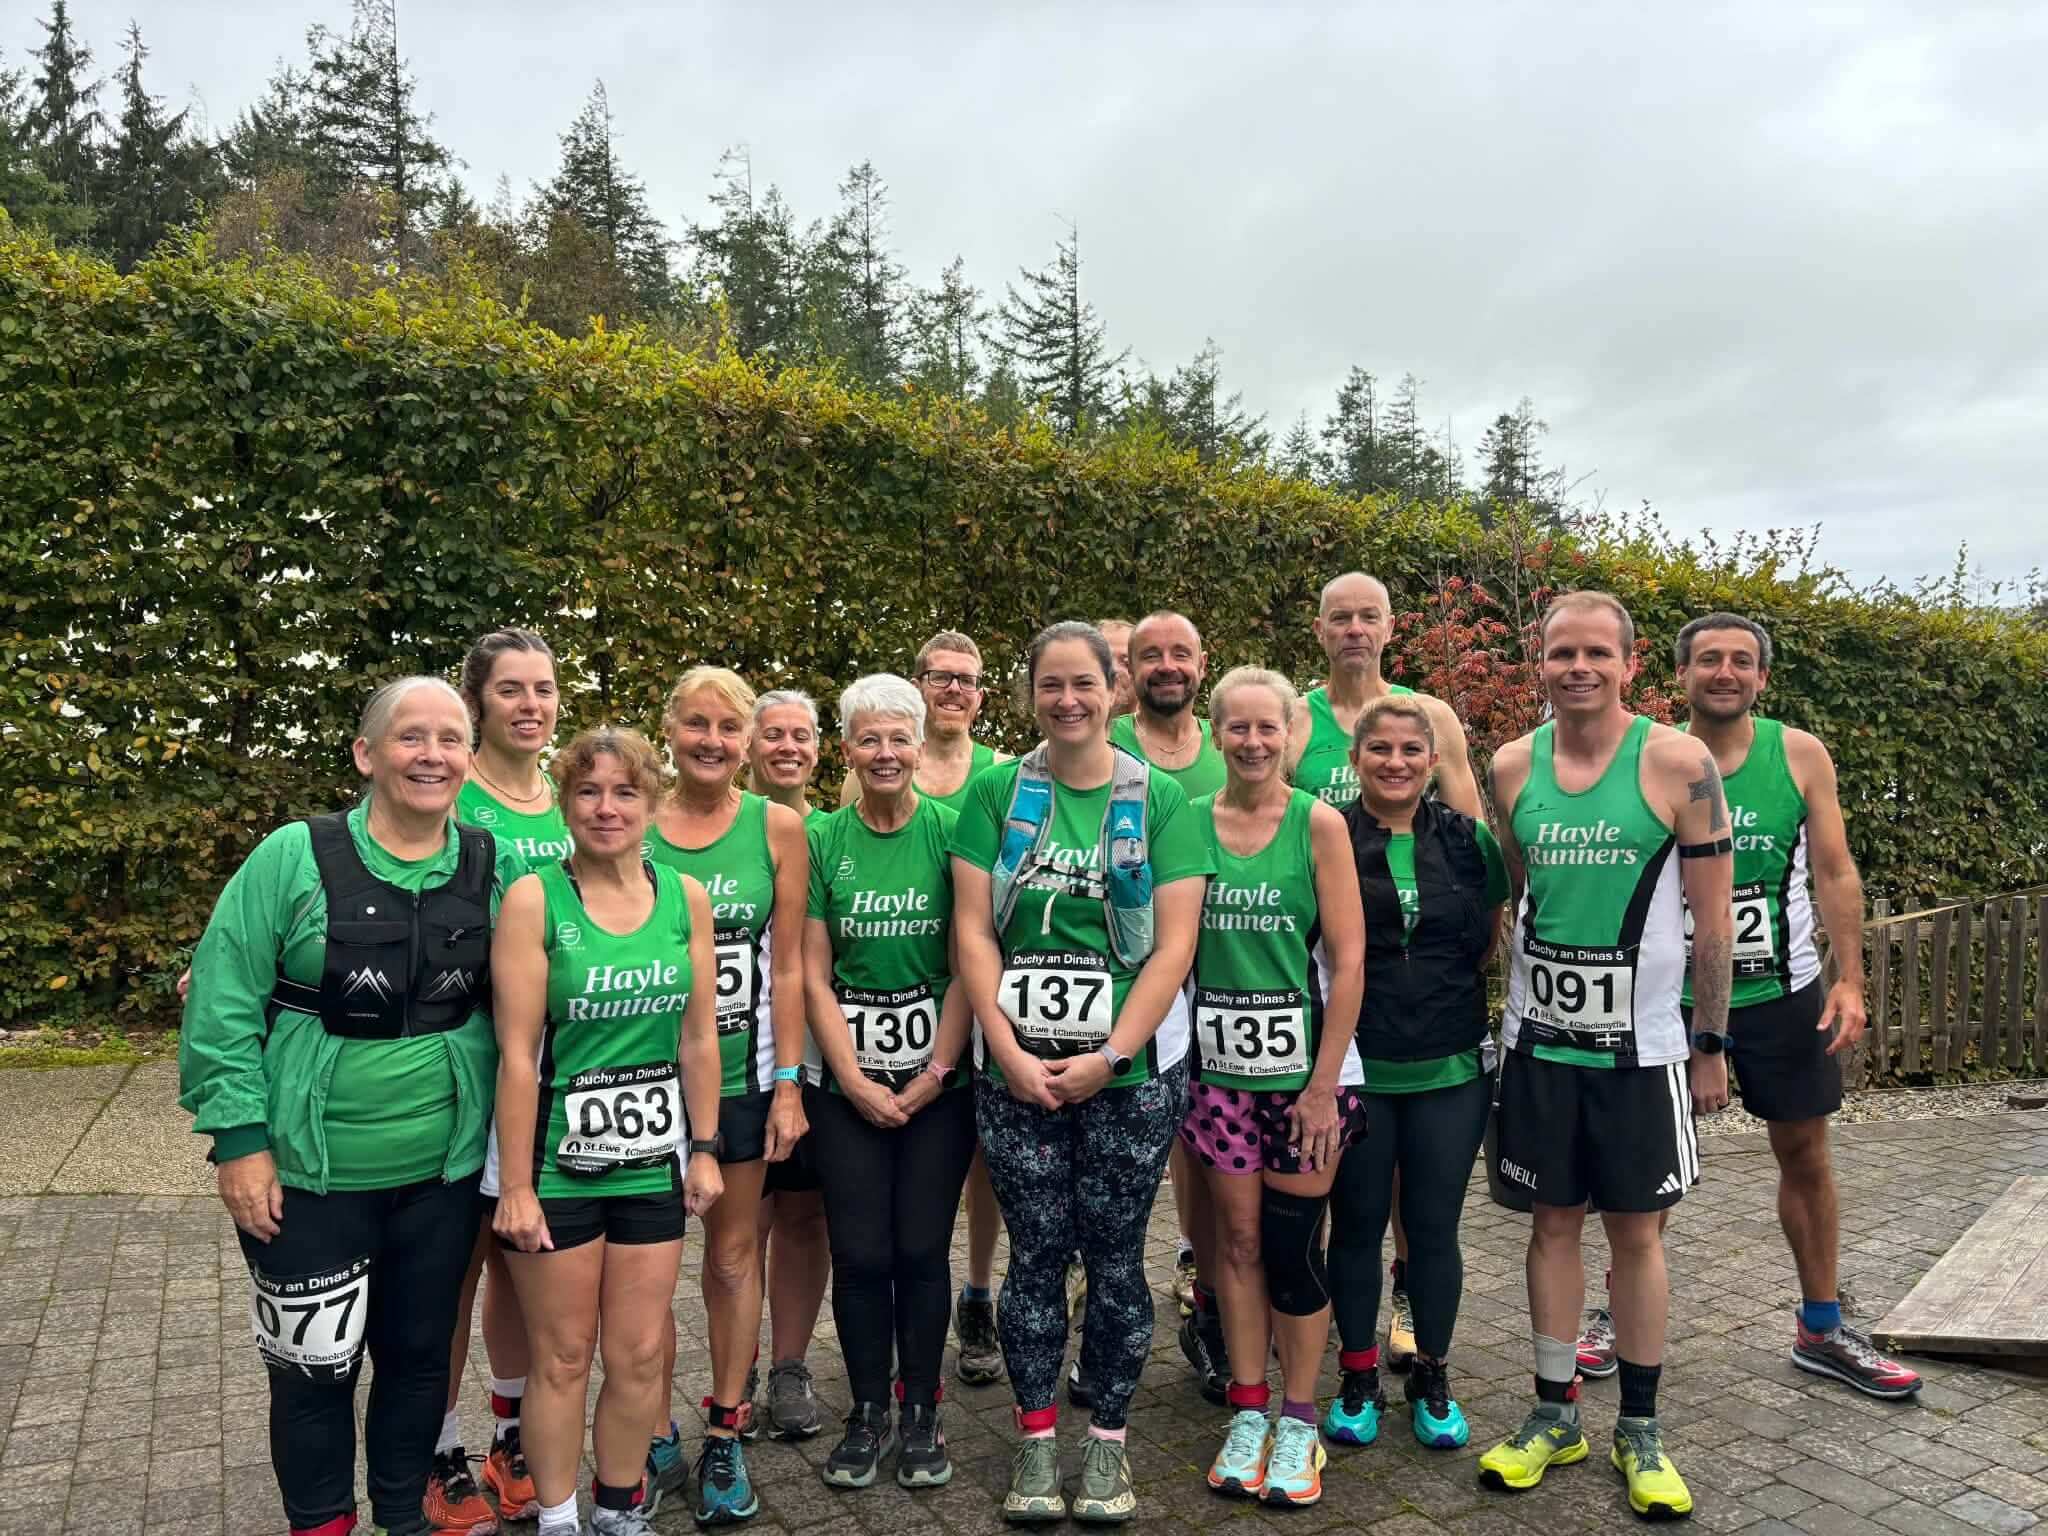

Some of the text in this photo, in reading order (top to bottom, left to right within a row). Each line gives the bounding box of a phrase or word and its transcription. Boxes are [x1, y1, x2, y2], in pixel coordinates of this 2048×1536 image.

[513, 834, 576, 861] Hayl
[1536, 820, 1621, 848] Hayle
[1527, 845, 1640, 865] Runners
[850, 888, 929, 917] Hayle
[1205, 881, 1281, 911] Hayle
[1732, 885, 1760, 898] inas 5
[839, 917, 941, 938] Runners
[1200, 908, 1297, 932] Runners
[1013, 954, 1045, 965] Duchy
[1046, 954, 1061, 964] an
[1063, 954, 1096, 965] Dinas
[1529, 940, 1624, 961] Duchy an Dinas 5
[583, 959, 679, 996] Hayle
[1531, 963, 1614, 1014] 091
[567, 991, 690, 1022] Runners
[845, 985, 926, 1003] Duchy an Dinas 5
[1011, 974, 1105, 1022] 137
[1205, 991, 1295, 1006] Duchy an Dinas 5
[847, 1008, 932, 1053] 130
[1206, 1014, 1297, 1059] 135
[575, 1063, 673, 1087] Duchy an Dinas 5
[579, 1086, 673, 1139] 063
[286, 1282, 304, 1292] an
[308, 1270, 350, 1290] Dinas
[352, 1262, 360, 1274] 5
[256, 1286, 360, 1346] 077
